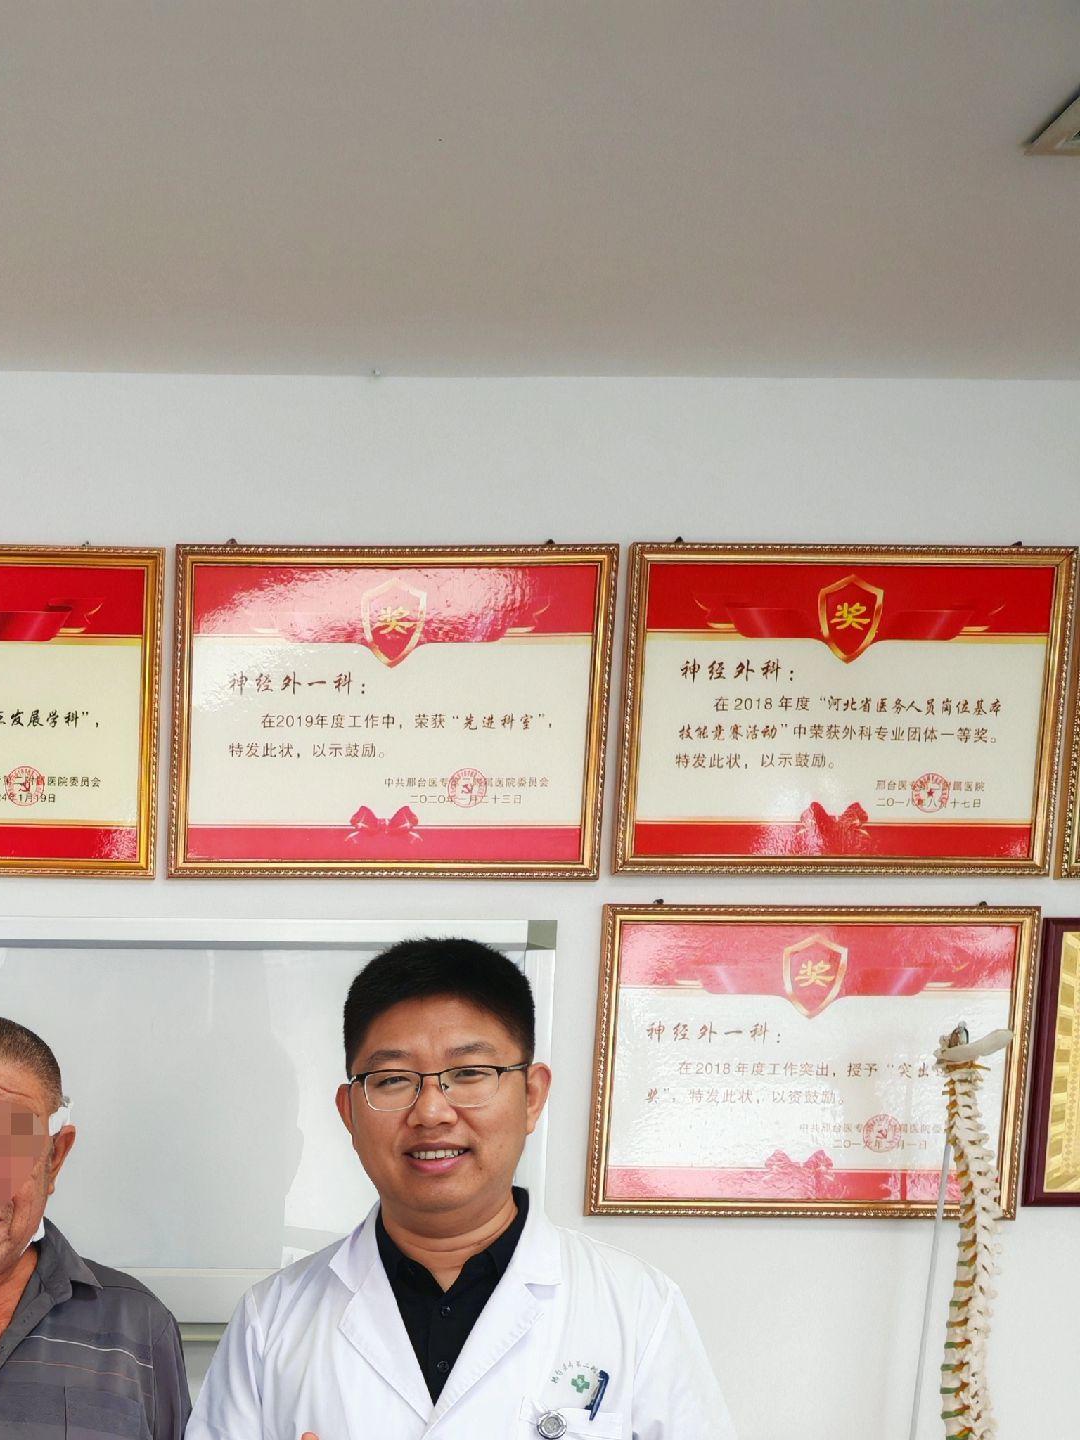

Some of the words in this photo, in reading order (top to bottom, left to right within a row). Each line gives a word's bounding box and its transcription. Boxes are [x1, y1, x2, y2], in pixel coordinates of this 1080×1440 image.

[377, 606, 414, 634] 奖
[830, 602, 871, 631] 奖
[796, 961, 834, 988] 奖
